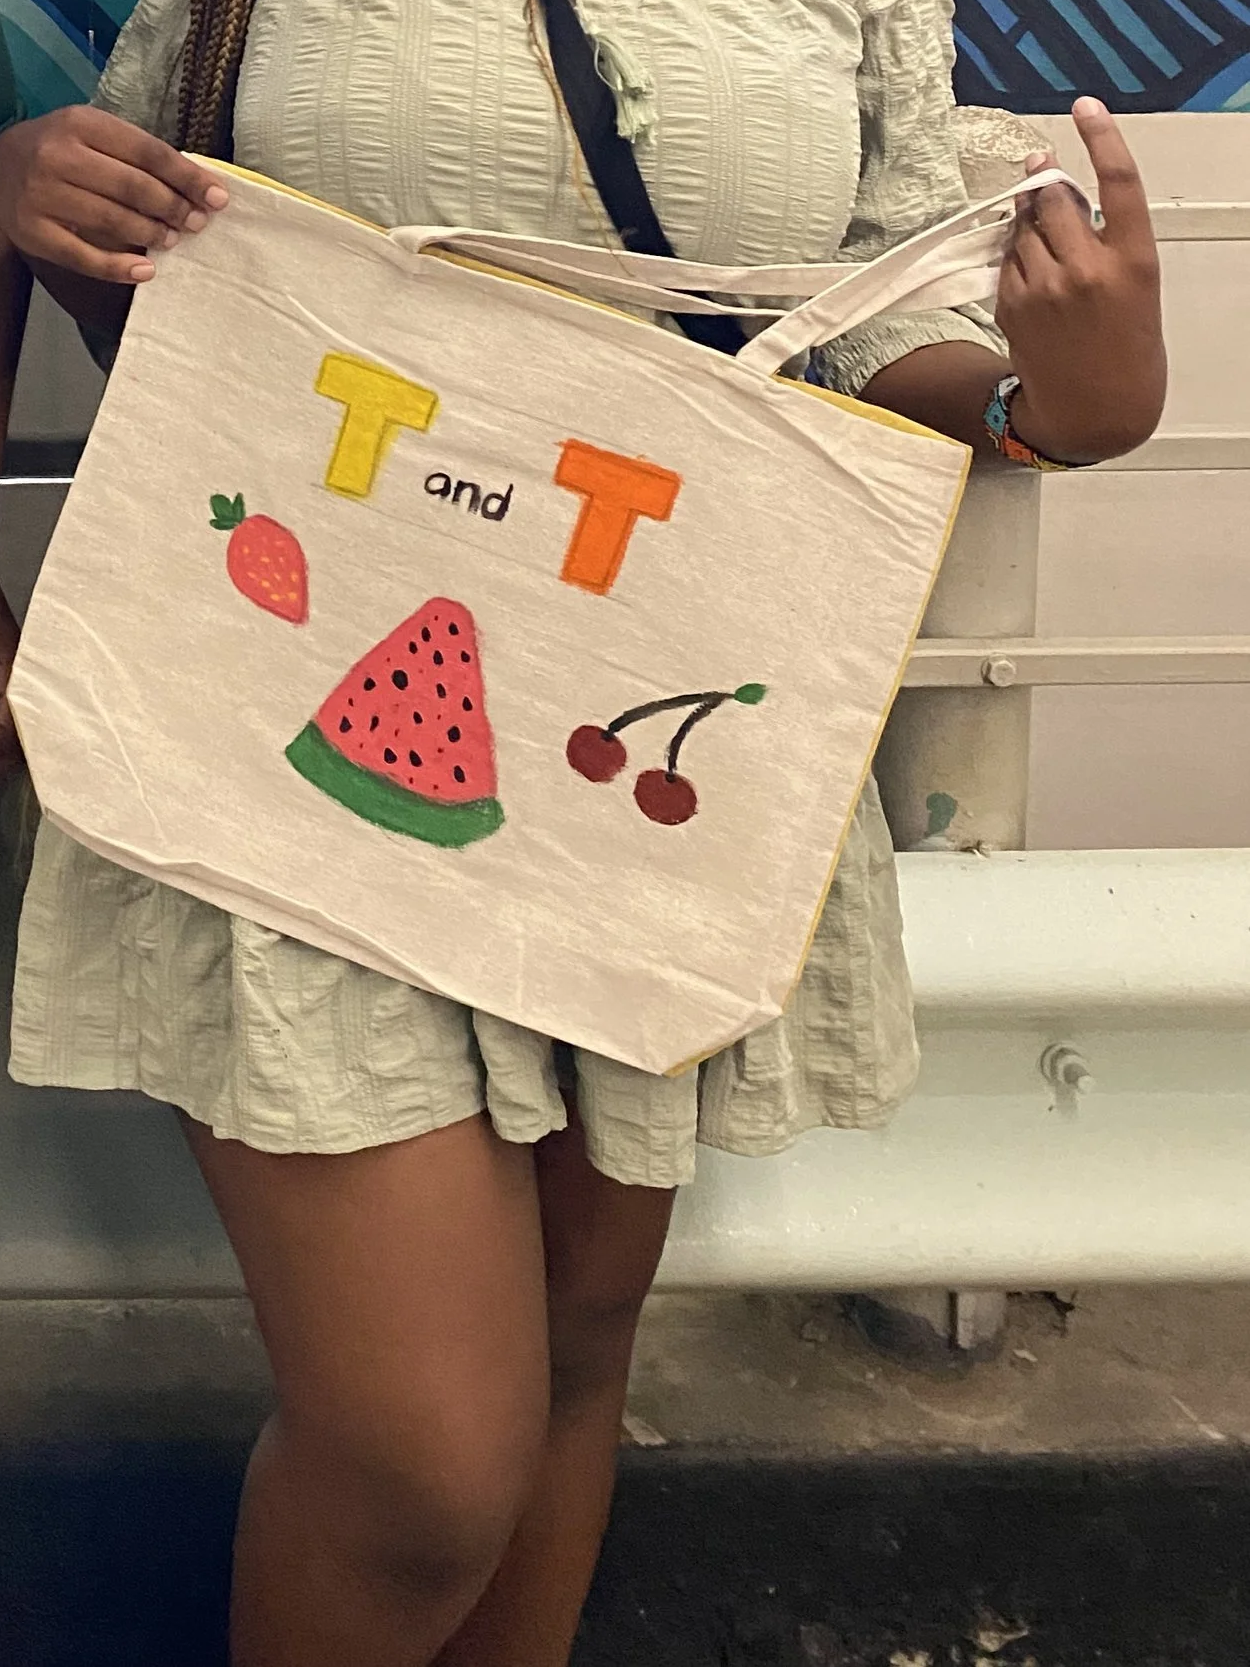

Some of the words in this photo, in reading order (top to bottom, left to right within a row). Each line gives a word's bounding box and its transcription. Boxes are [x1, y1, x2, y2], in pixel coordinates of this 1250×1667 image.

[314, 351, 440, 499] T
[423, 471, 514, 522] and
[554, 438, 684, 596] T
